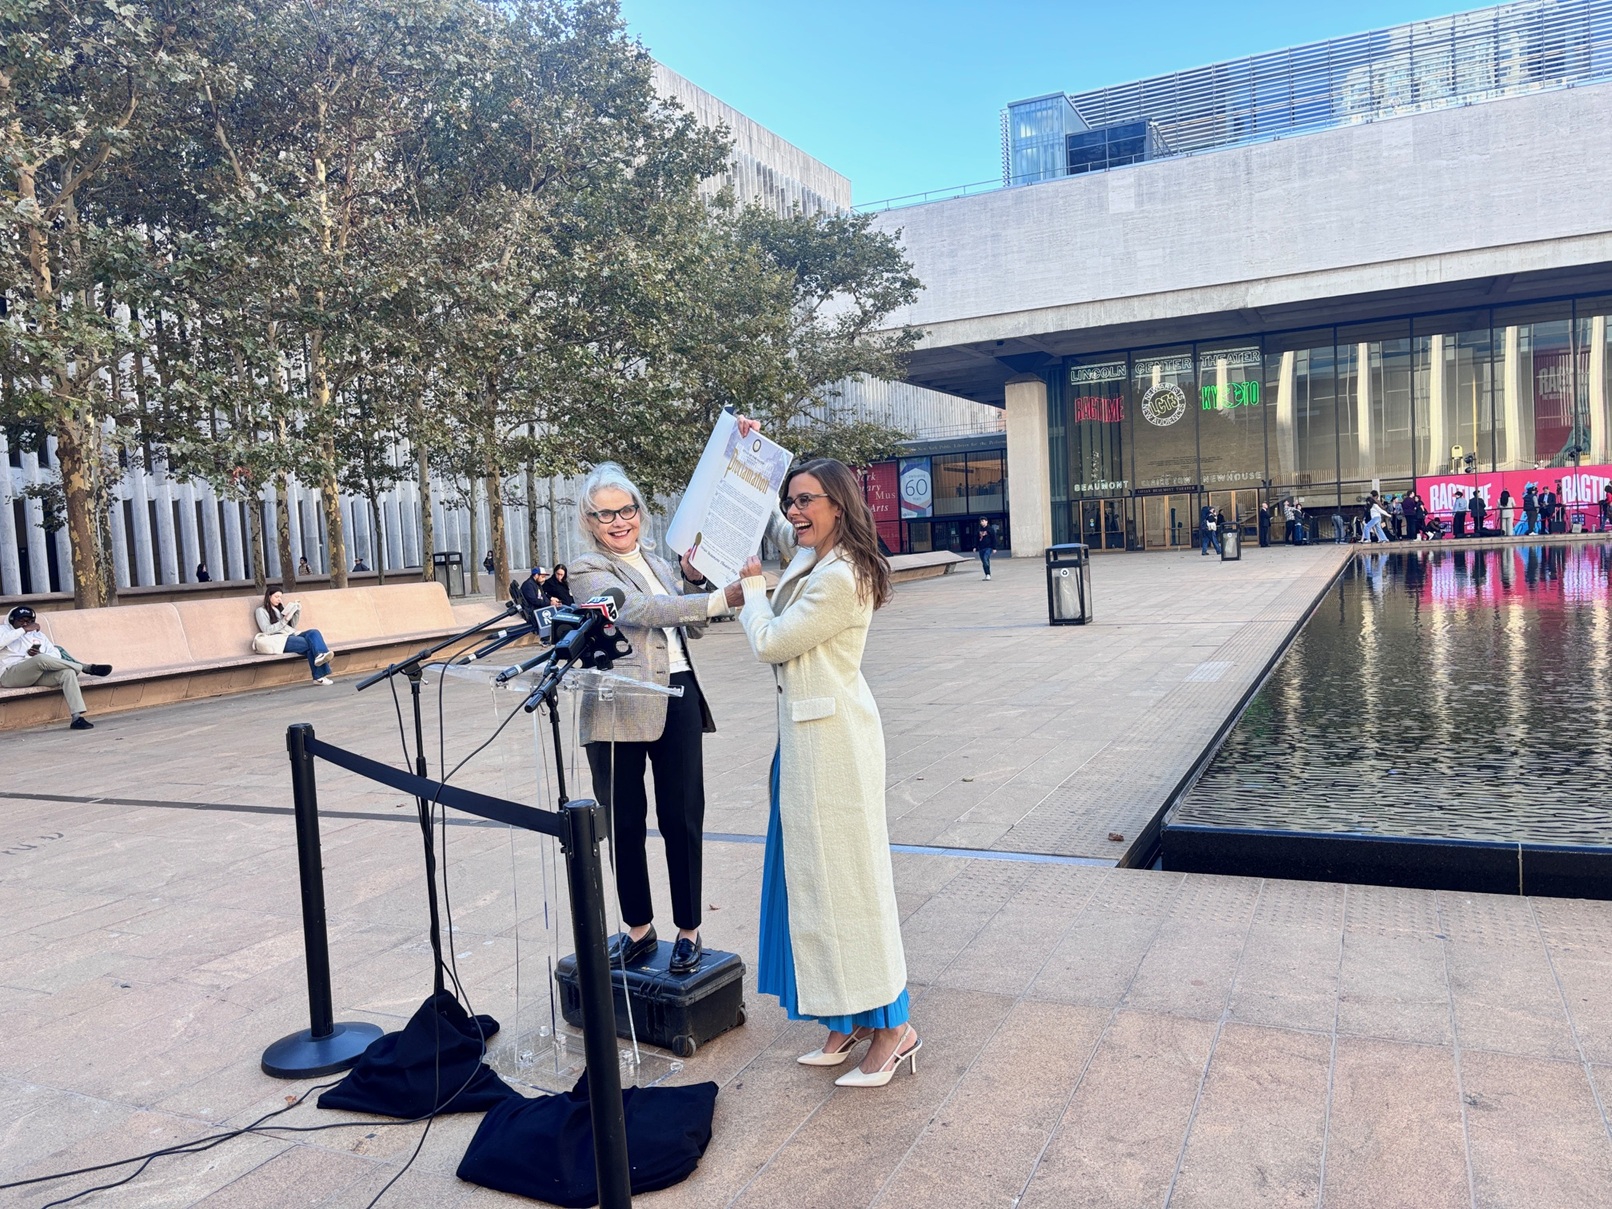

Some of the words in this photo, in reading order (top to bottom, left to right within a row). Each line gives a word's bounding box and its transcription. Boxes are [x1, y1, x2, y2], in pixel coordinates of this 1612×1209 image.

[1071, 365, 1126, 382] LINCOLN
[1135, 357, 1192, 374] CENTER
[1201, 350, 1260, 367] THEATER
[1074, 396, 1125, 423] RAGTIME
[1150, 391, 1179, 417] LCT3
[724, 448, 769, 494] Proclamation
[1202, 471, 1262, 484] NEWHOUSE
[905, 478, 928, 497] 60
[1074, 480, 1129, 492] BEAUMONT
[870, 504, 889, 513] Arts
